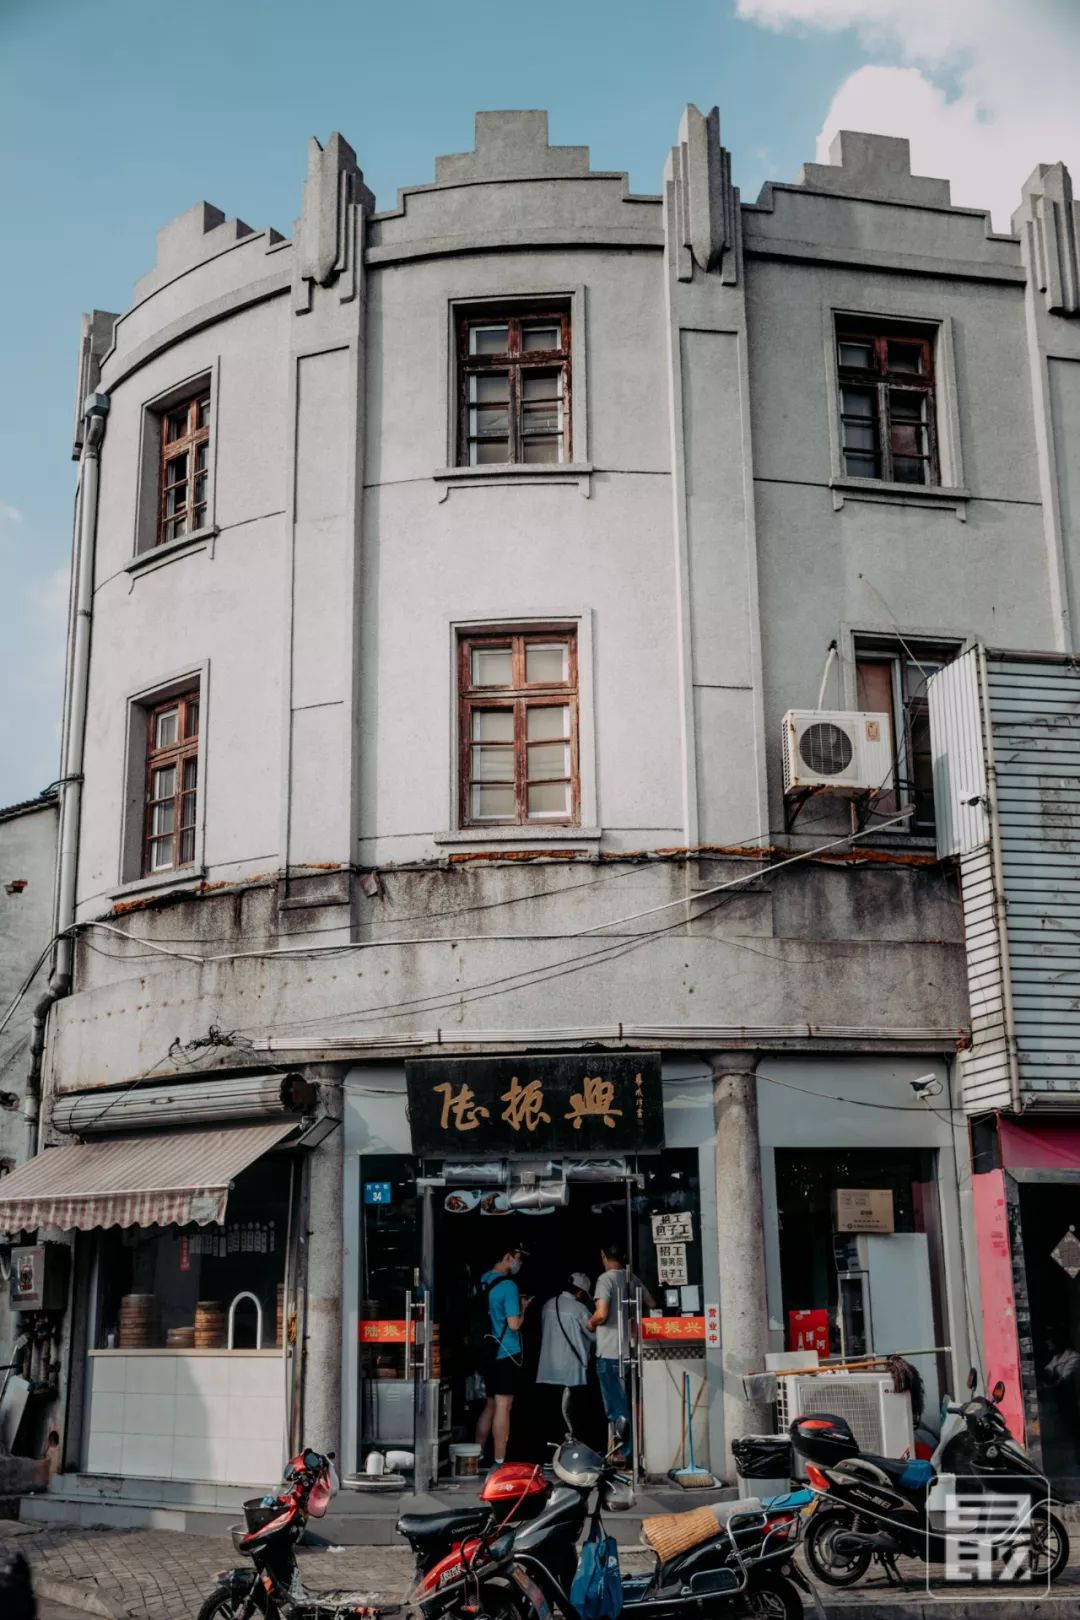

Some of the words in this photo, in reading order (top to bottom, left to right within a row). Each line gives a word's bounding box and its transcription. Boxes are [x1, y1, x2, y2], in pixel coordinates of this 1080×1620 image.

[372, 1191, 382, 1202] 34
[660, 1214, 683, 1225] 招工
[656, 1224, 690, 1236] 包子工
[660, 1246, 684, 1257] 招工
[661, 1269, 685, 1279] 包子工
[707, 1306, 718, 1344] 营业中
